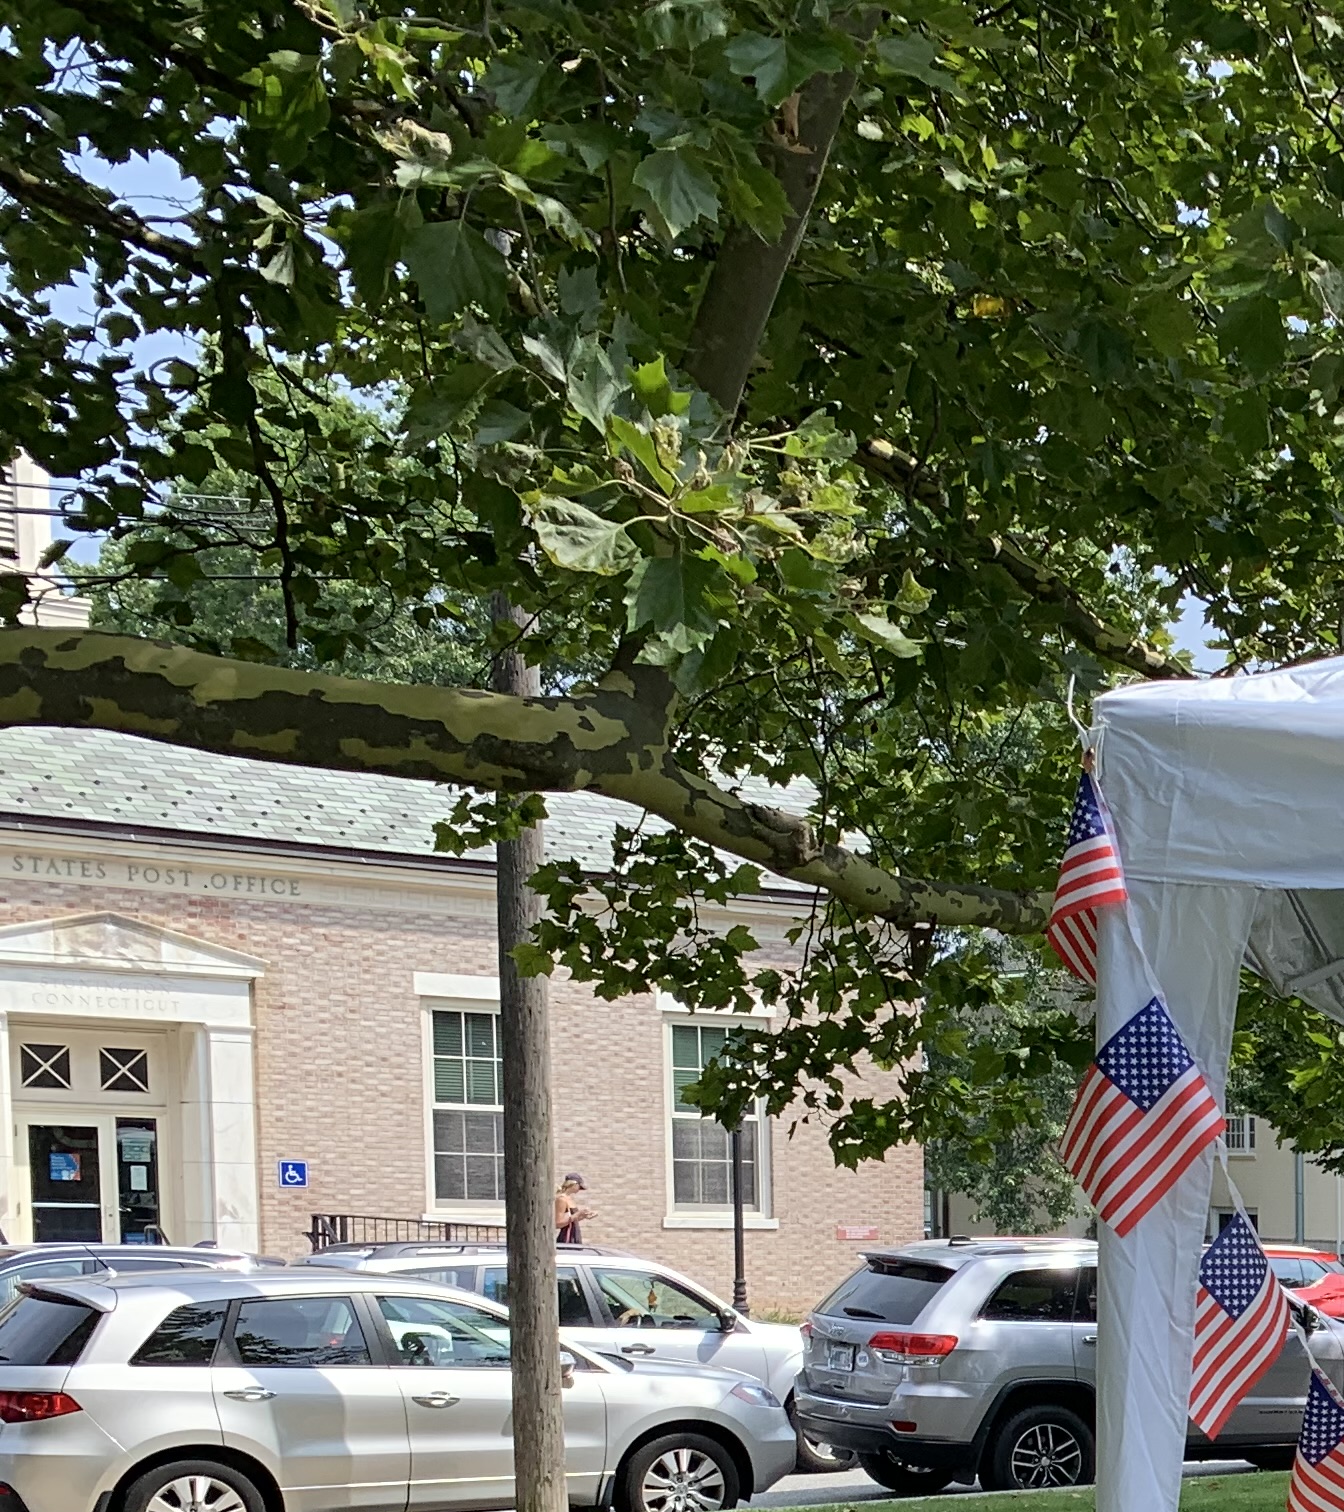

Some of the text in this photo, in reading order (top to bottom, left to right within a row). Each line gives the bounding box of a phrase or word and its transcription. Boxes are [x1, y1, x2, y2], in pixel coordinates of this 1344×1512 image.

[12, 854, 301, 896] STATES POST OFFICE
[31, 992, 180, 1014] CONNECTICUT
